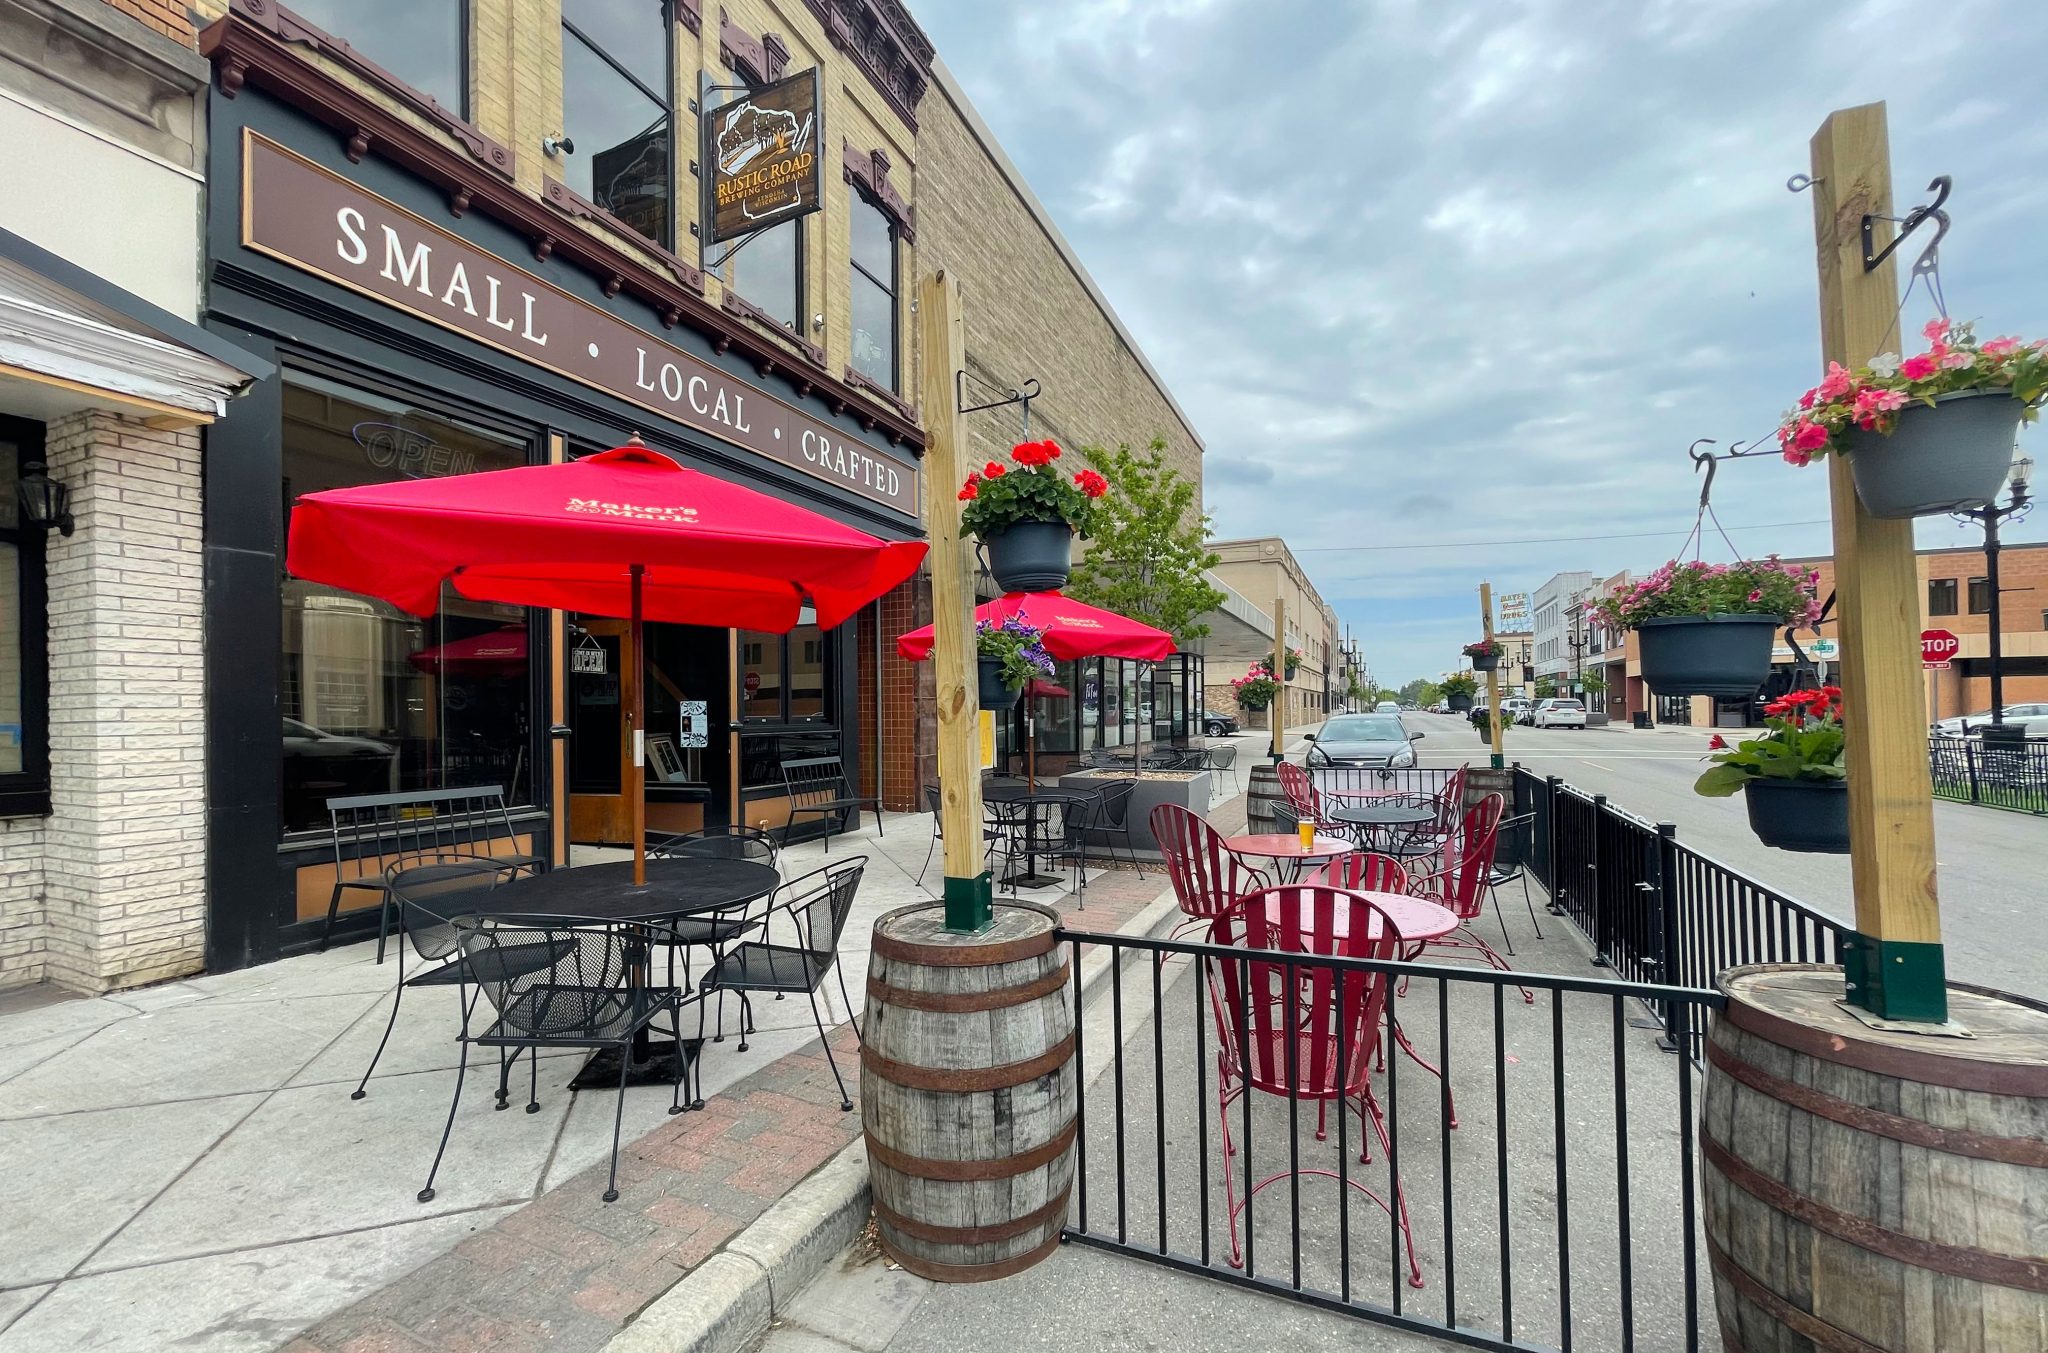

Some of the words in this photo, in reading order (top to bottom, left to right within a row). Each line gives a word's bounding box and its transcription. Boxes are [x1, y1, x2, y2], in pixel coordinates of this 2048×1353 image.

[717, 167, 768, 199] RUSTIC
[770, 152, 812, 180] ROAD
[720, 185, 761, 206] BREWING
[764, 168, 810, 190] COMPANY
[754, 193, 788, 208] WISCONSIN
[336, 207, 548, 347] SMALL
[636, 347, 750, 434] LOCAL
[801, 429, 900, 497] CRAFTED
[367, 430, 475, 476] OPEN
[567, 497, 698, 515] Maker's
[601, 508, 700, 523] Mark
[574, 655, 604, 667] OPEN
